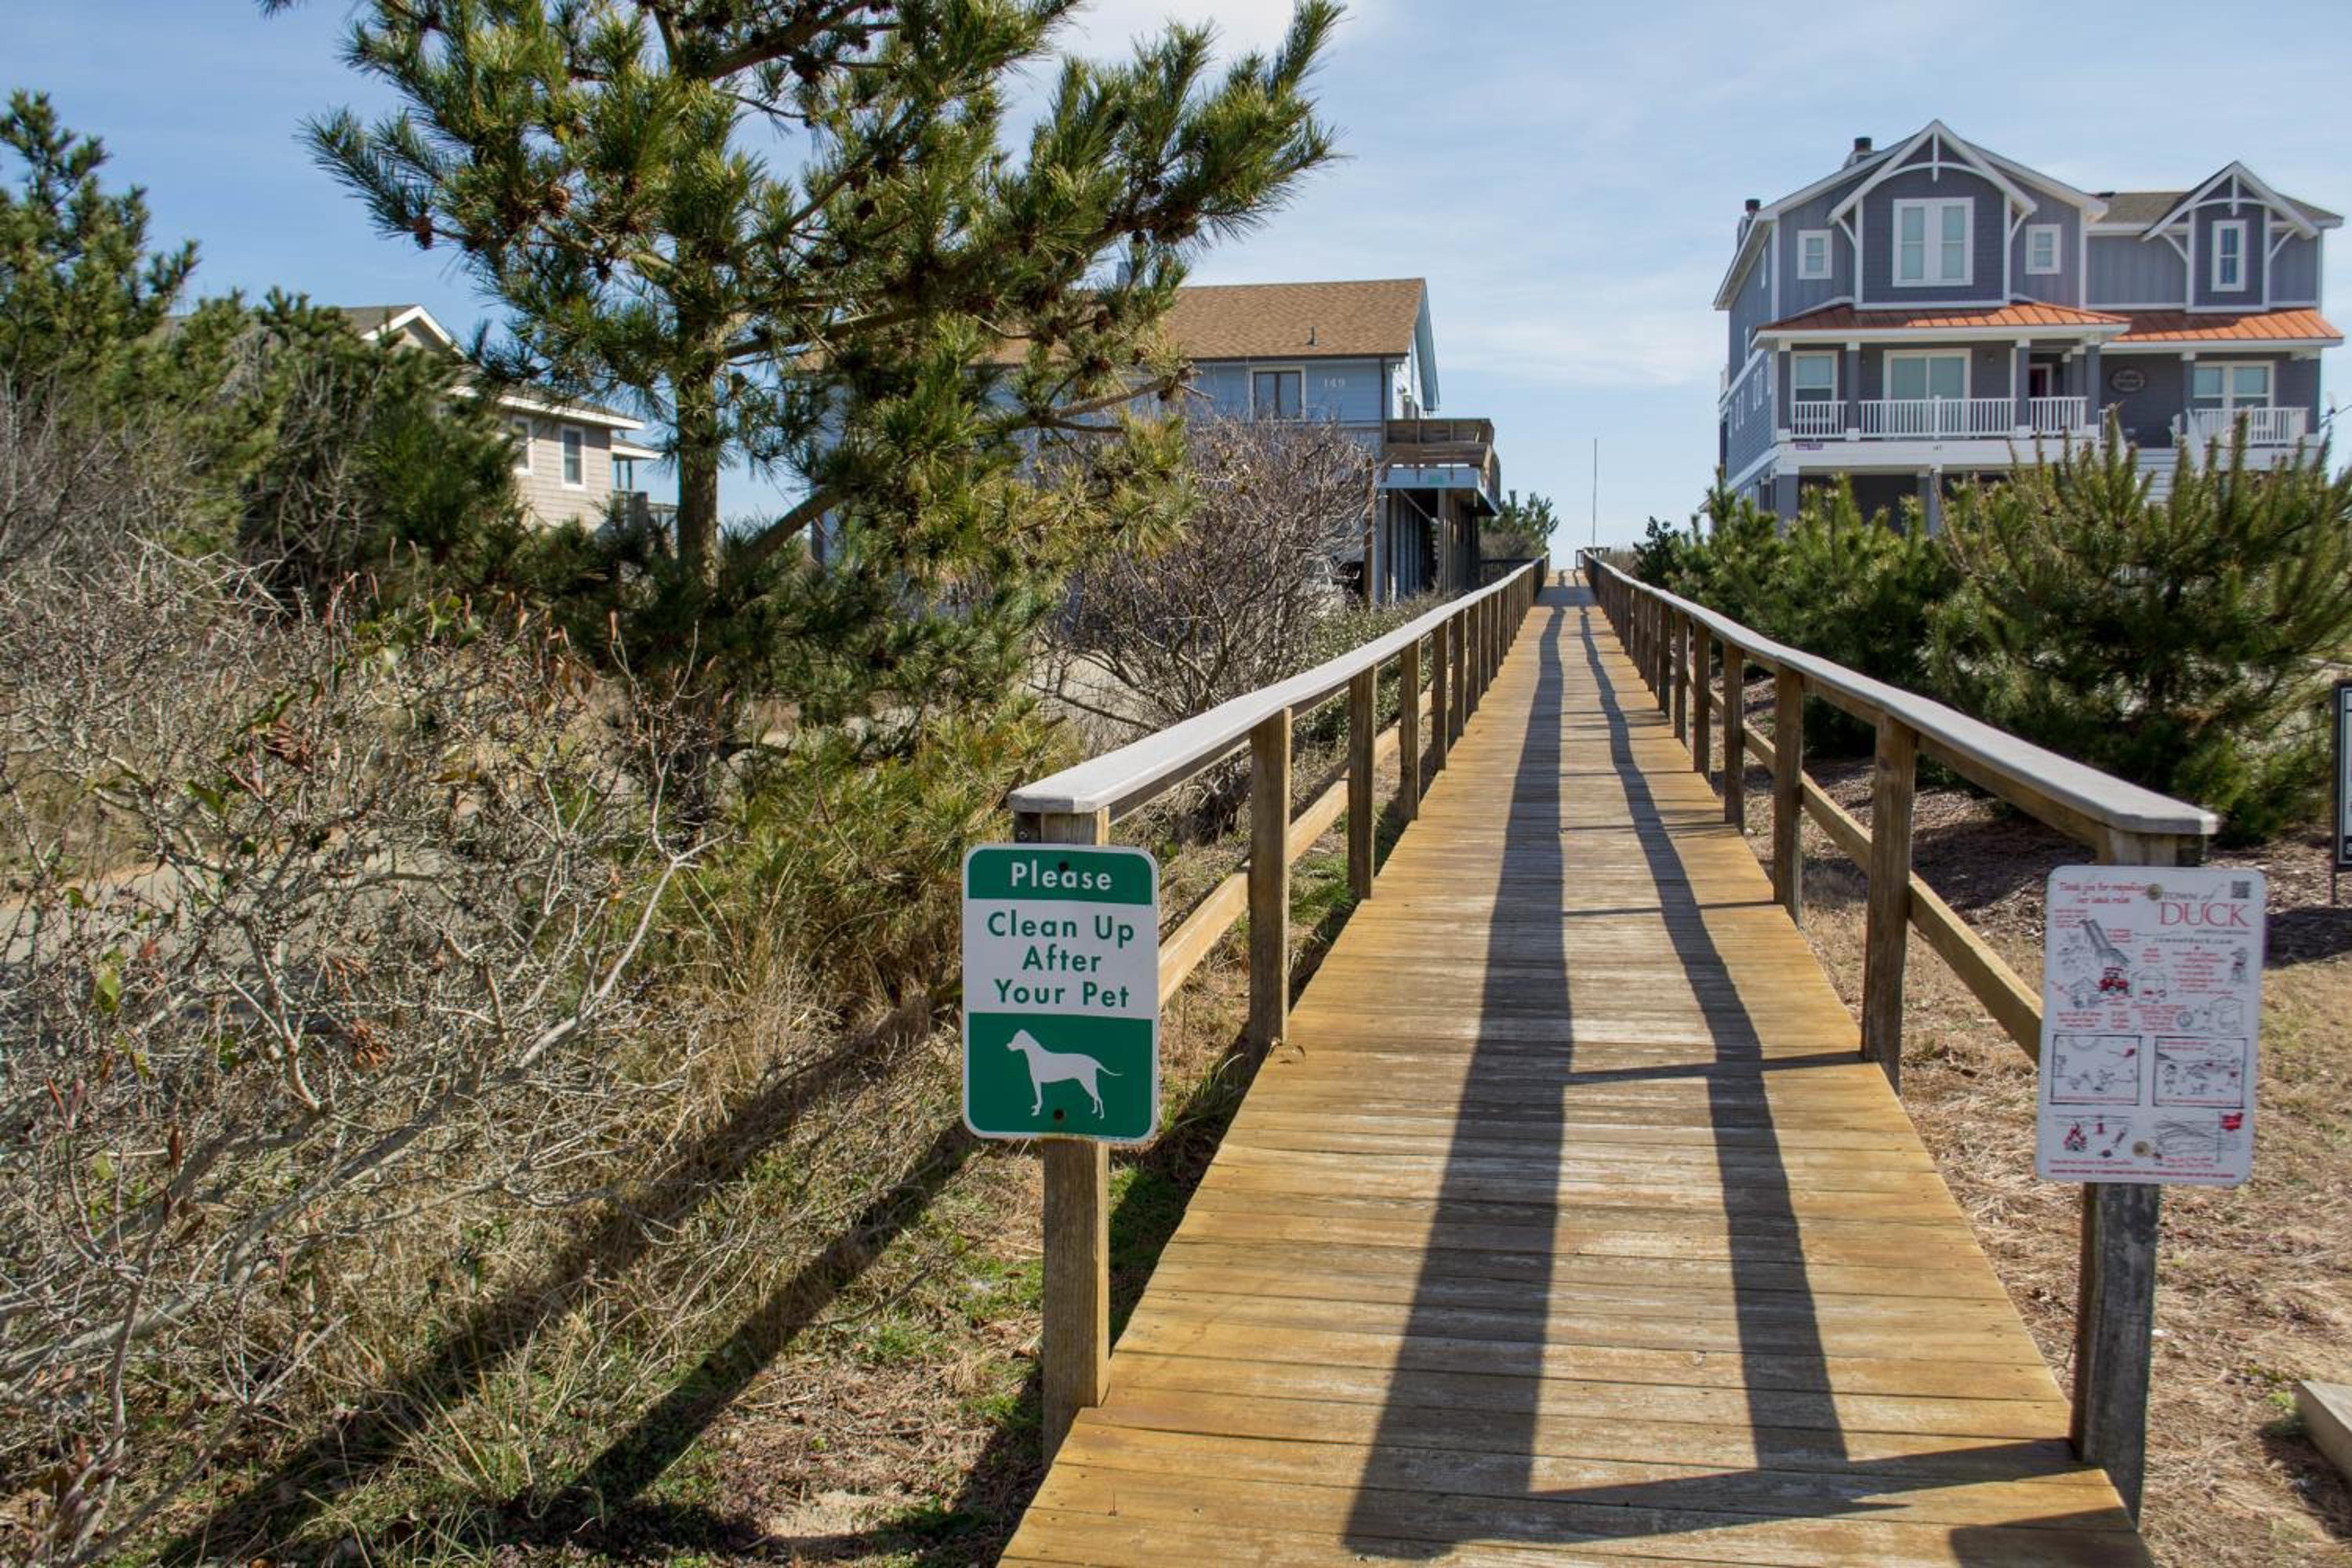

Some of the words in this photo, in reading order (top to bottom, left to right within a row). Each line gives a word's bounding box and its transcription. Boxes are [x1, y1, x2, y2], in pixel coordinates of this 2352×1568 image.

[1324, 377, 1346, 388] 149
[1011, 859, 1112, 891] Please
[2162, 892, 2198, 901] TOWN
[987, 909, 1078, 938] Clean
[1094, 915, 1135, 949] Up
[2160, 902, 2251, 927] DUCK
[1022, 944, 1102, 973] After
[994, 978, 1065, 1005] Your
[1083, 981, 1131, 1007] Pet
